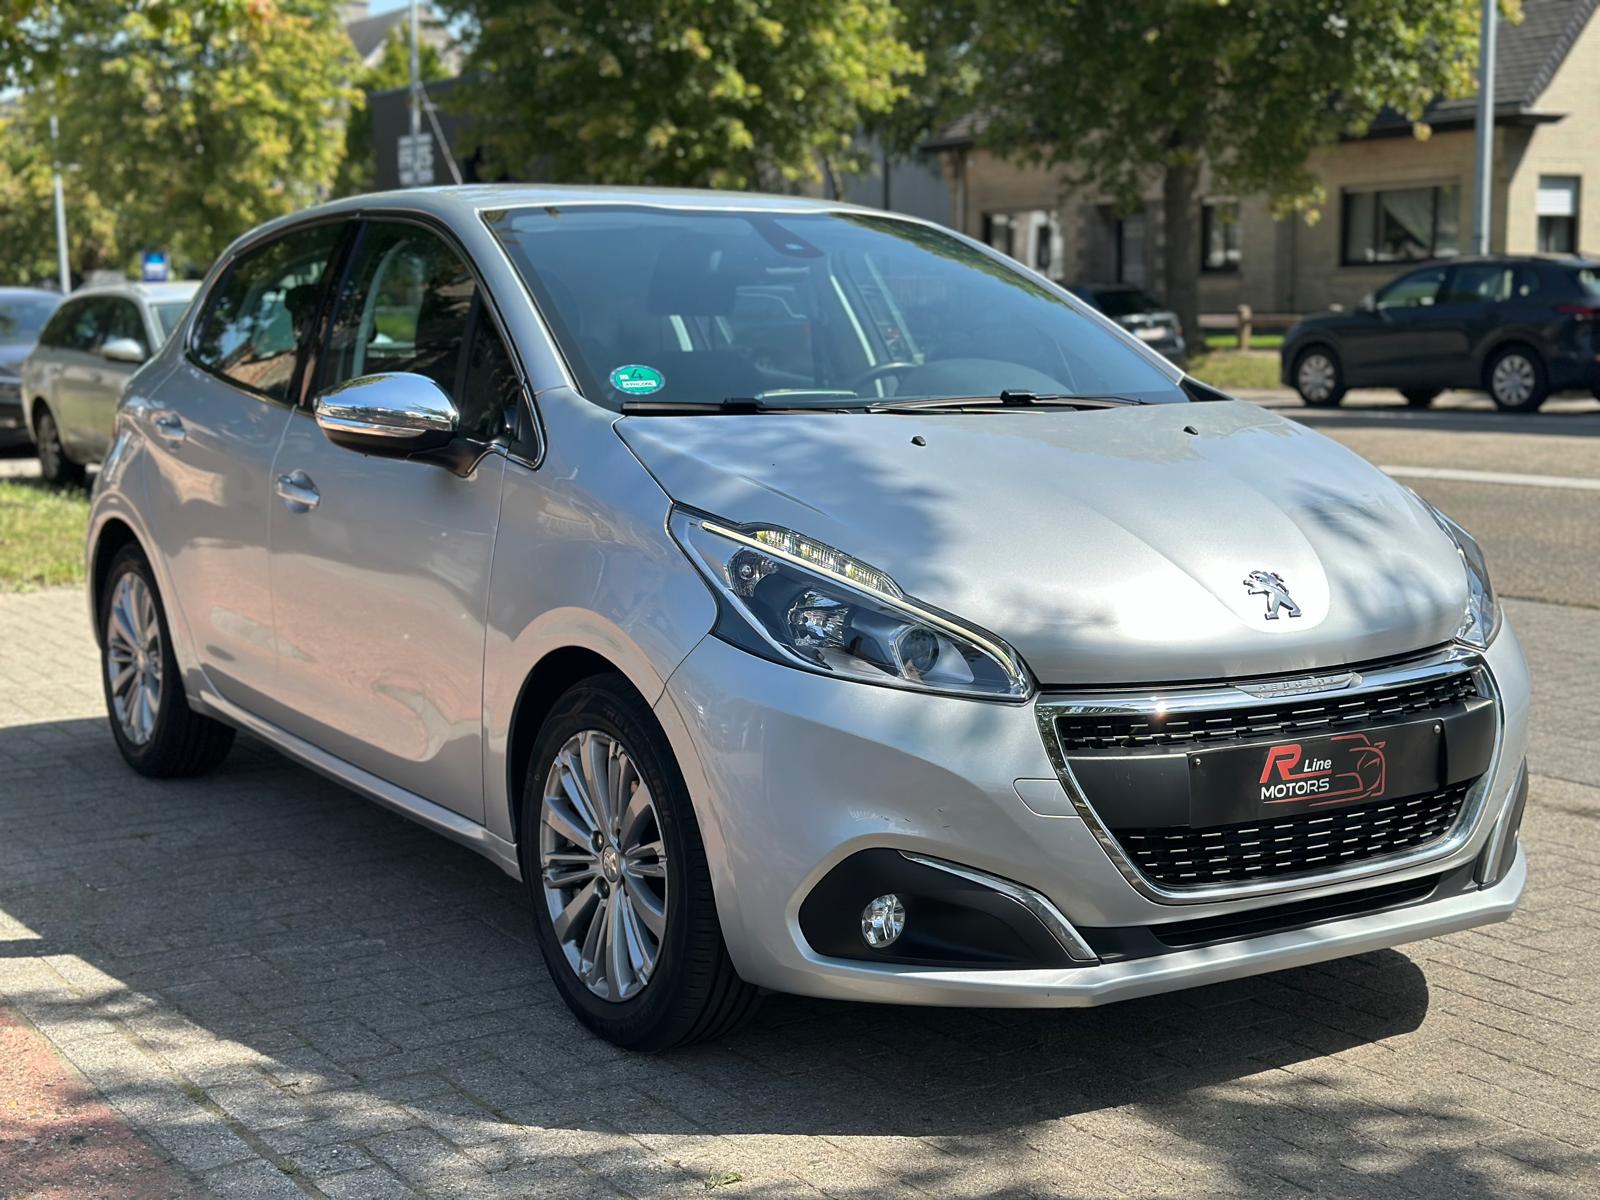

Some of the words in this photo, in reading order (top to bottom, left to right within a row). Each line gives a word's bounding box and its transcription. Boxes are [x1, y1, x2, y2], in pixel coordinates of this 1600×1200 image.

[631, 368, 643, 380] 4
[1303, 758, 1332, 773] Line
[1260, 778, 1330, 800] MOTORS
